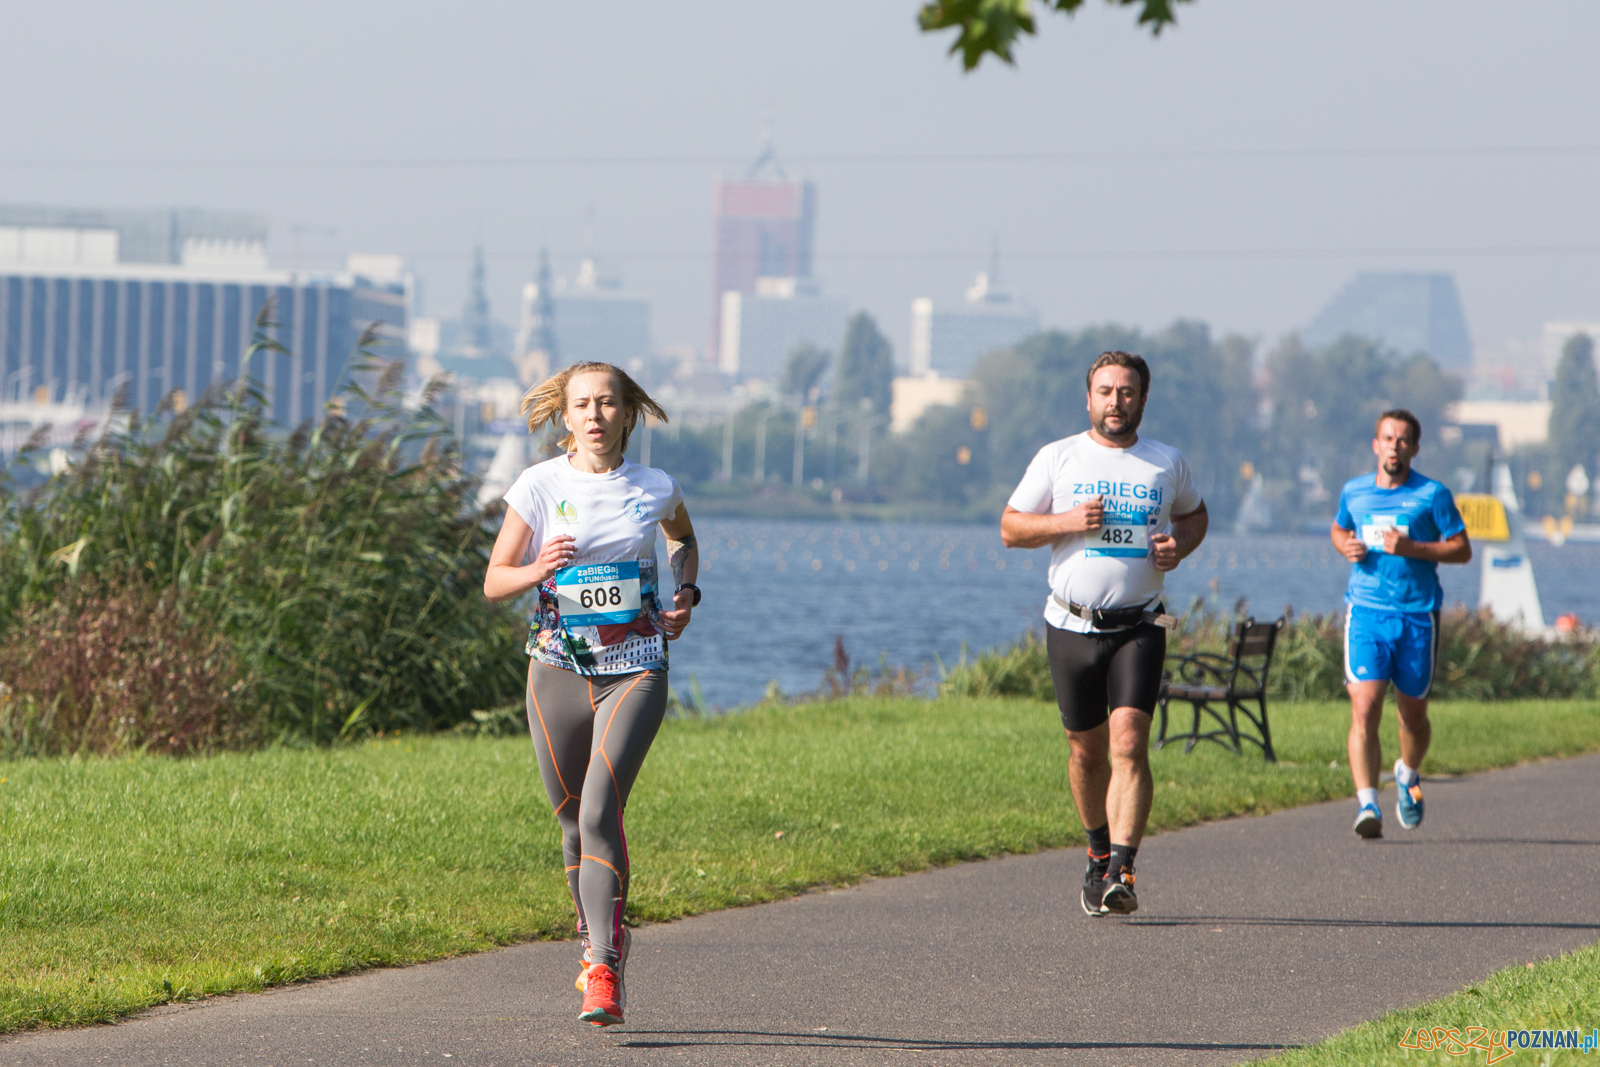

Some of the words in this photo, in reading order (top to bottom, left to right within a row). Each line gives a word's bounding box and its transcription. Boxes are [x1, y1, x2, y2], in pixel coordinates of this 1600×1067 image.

[1073, 480, 1163, 505] zaBIEGaj
[1101, 528, 1133, 544] 482
[577, 565, 619, 577] zaBIEGaj
[585, 574, 620, 583] FUNdusze
[580, 586, 622, 608] 608
